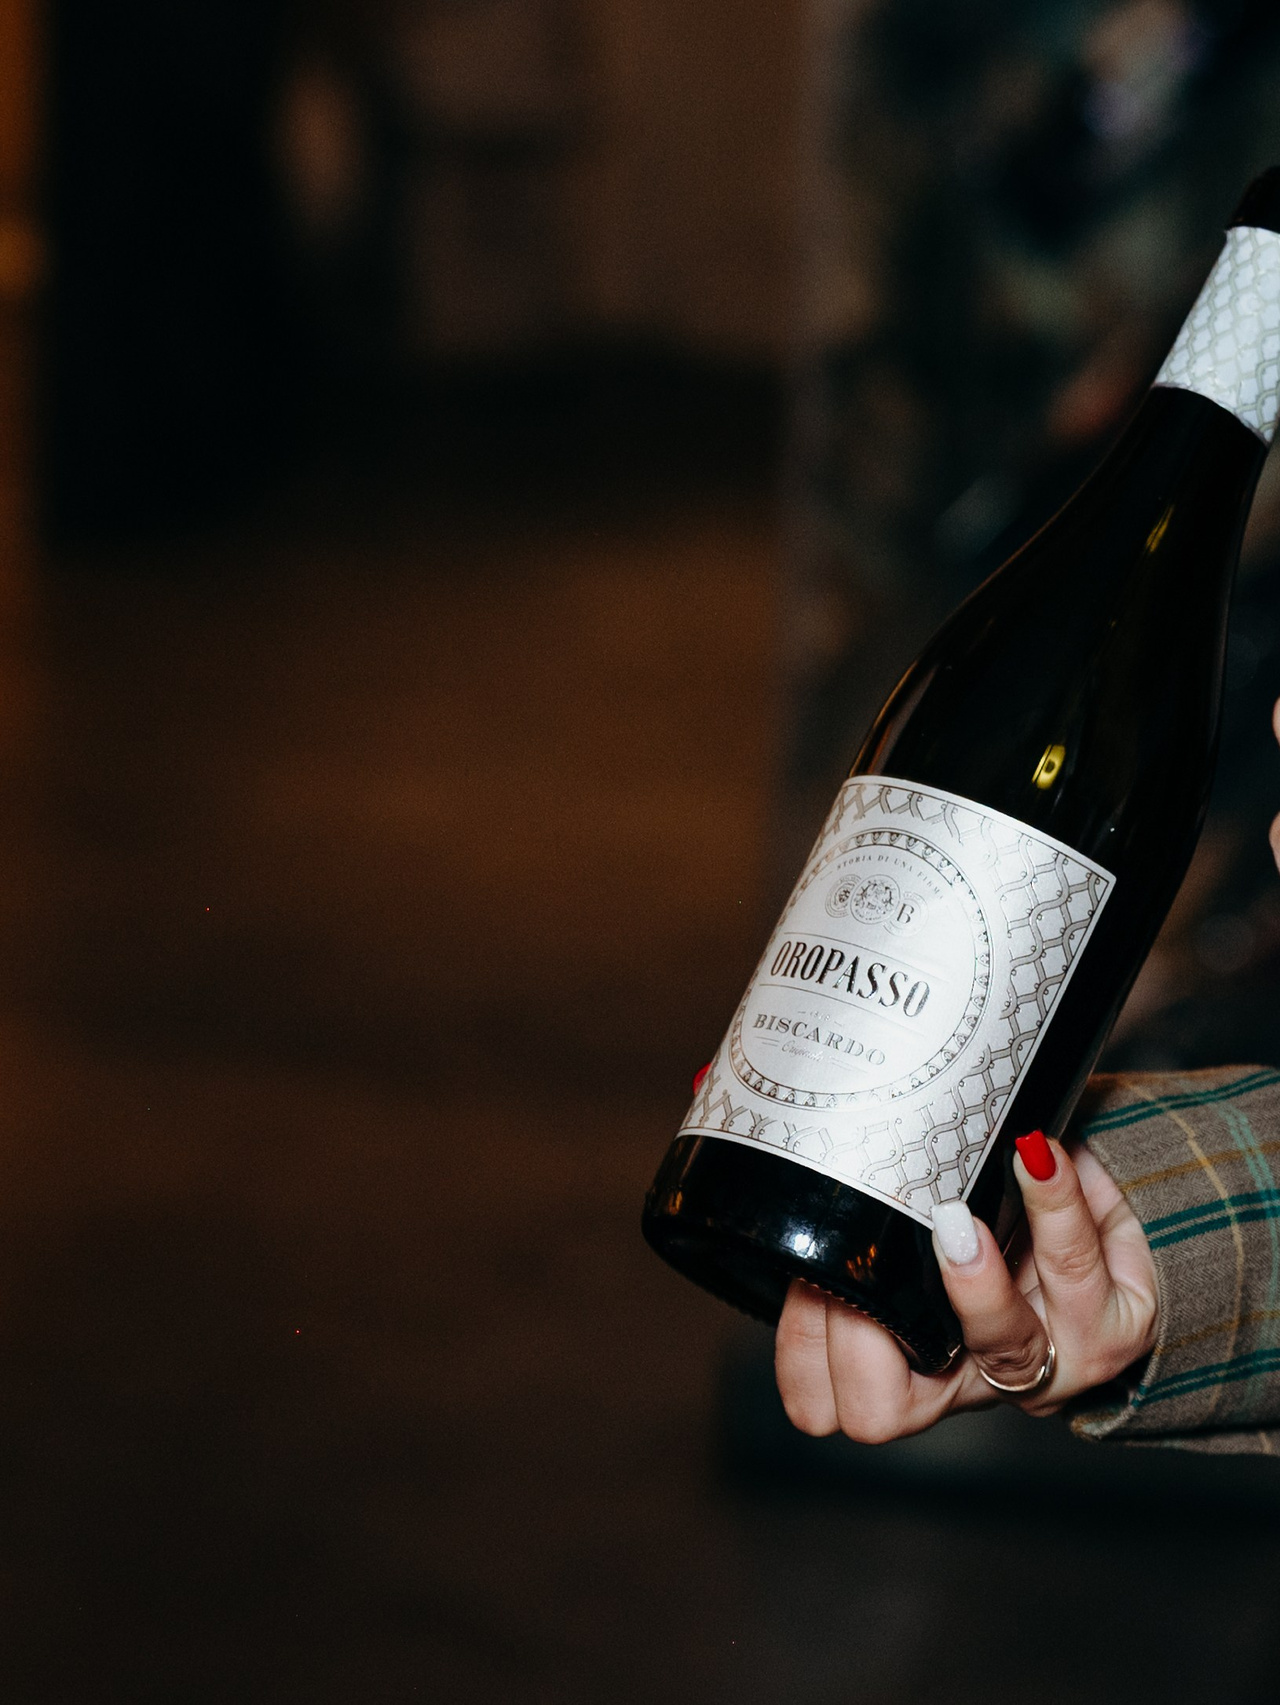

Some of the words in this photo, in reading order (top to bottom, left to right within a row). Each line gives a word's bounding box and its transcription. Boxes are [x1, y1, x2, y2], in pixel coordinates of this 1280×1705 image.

[836, 854, 873, 870] STORIA
[877, 854, 889, 862] DI
[894, 857, 913, 872] UNA
[896, 902, 915, 924] B
[770, 940, 931, 1018] OROPASSO
[752, 1013, 886, 1066] BISCARDO
